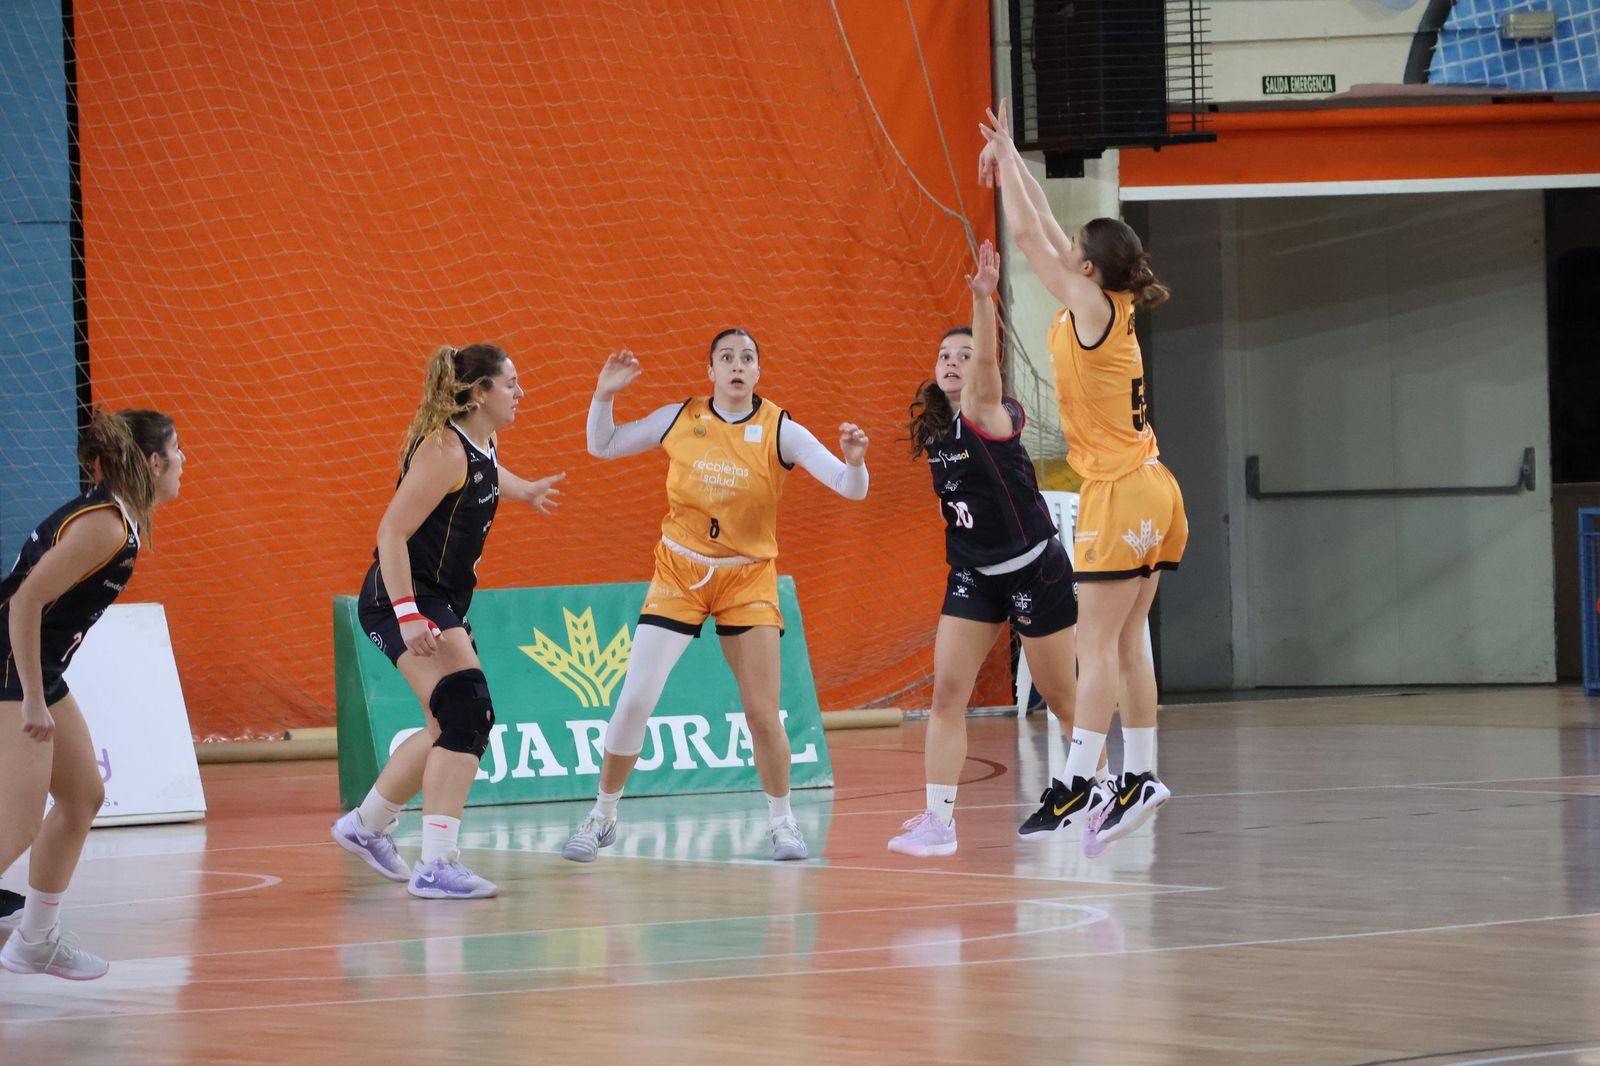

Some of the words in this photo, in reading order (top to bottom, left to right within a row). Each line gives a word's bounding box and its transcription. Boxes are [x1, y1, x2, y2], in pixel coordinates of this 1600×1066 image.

[1265, 76, 1290, 93] SALIDA
[1290, 75, 1333, 92] EMERGENCIA
[692, 459, 750, 478] recoletas
[703, 473, 737, 488] salud
[946, 501, 974, 529] 10
[709, 517, 720, 539] 8
[388, 721, 569, 784] JA
